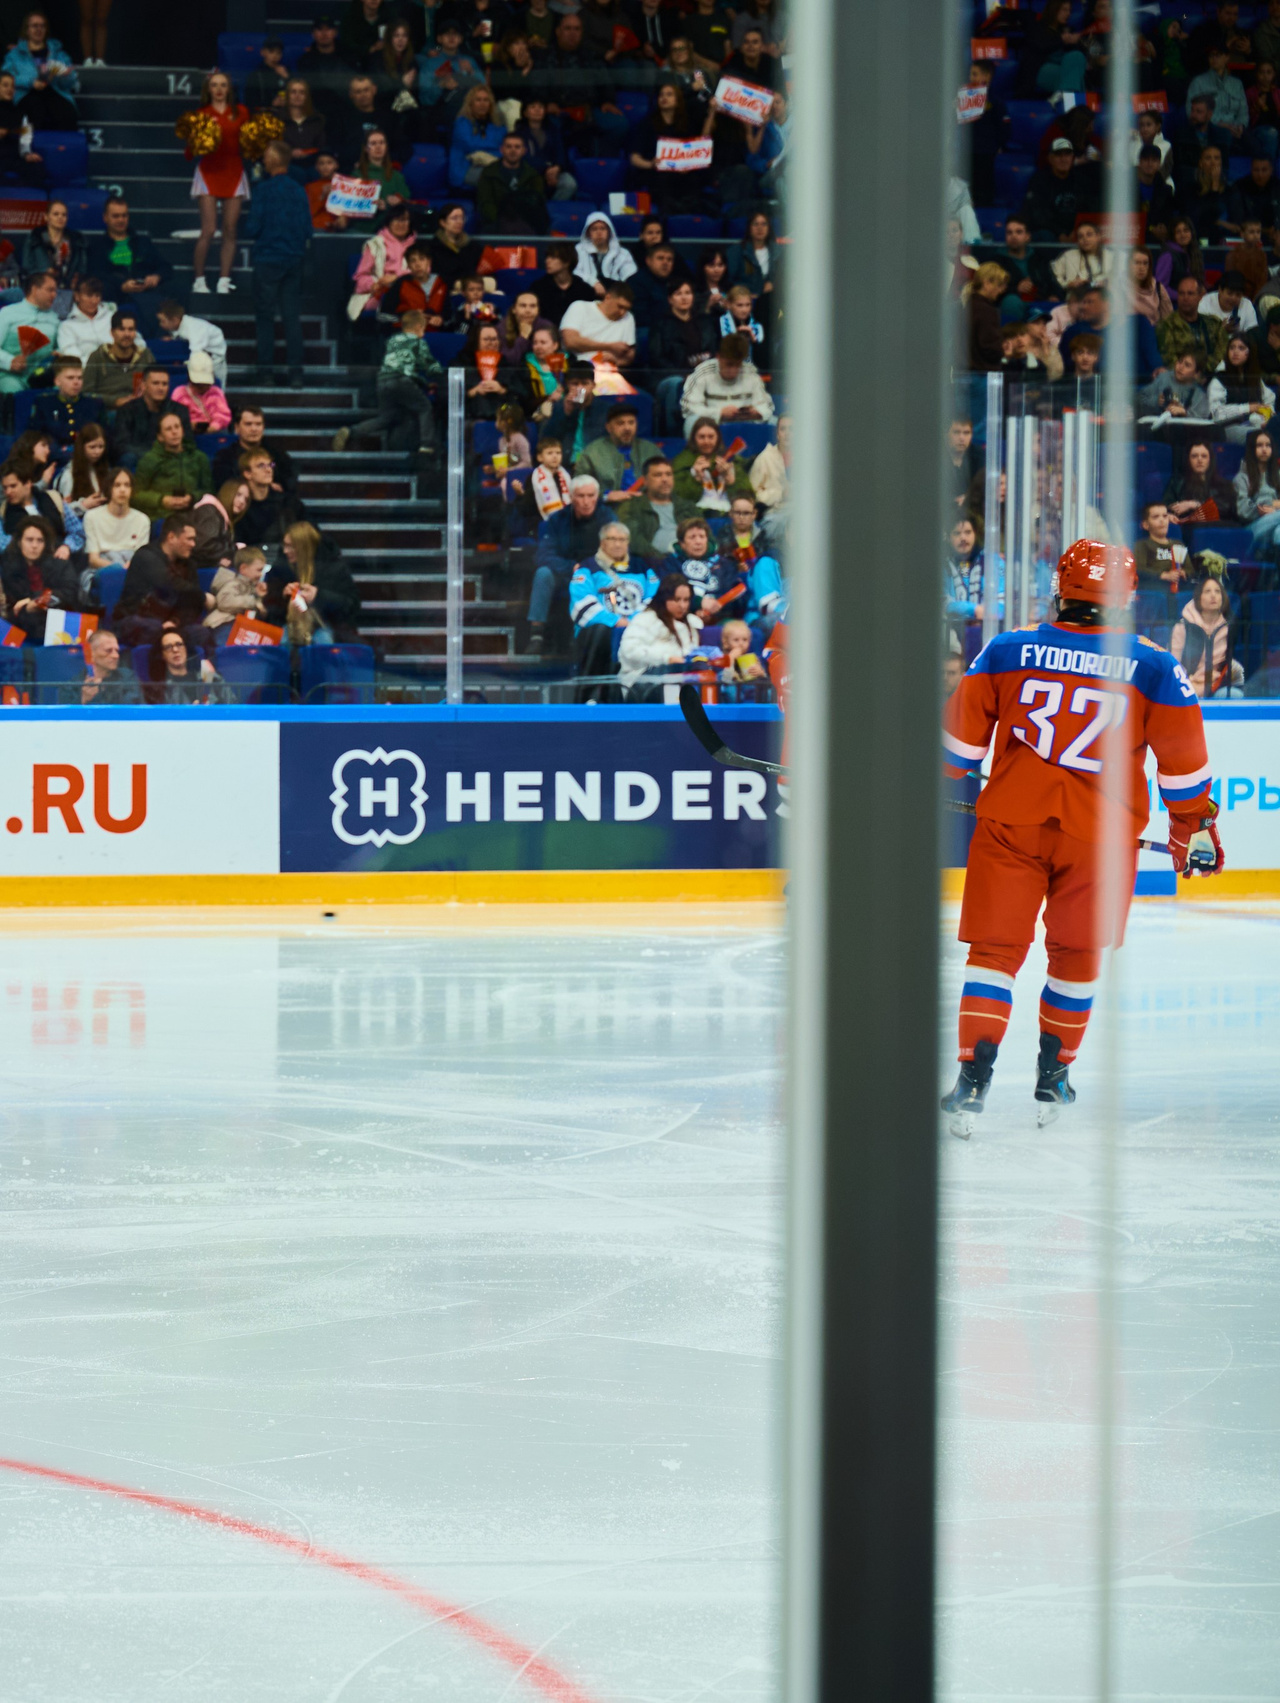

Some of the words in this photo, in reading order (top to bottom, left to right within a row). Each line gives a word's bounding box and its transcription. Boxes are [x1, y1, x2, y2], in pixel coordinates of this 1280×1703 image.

[167, 74, 191, 95] 14
[79, 128, 104, 149] 3
[1088, 565, 1106, 581] 32
[1012, 678, 1128, 774] 32
[359, 776, 399, 817] H
